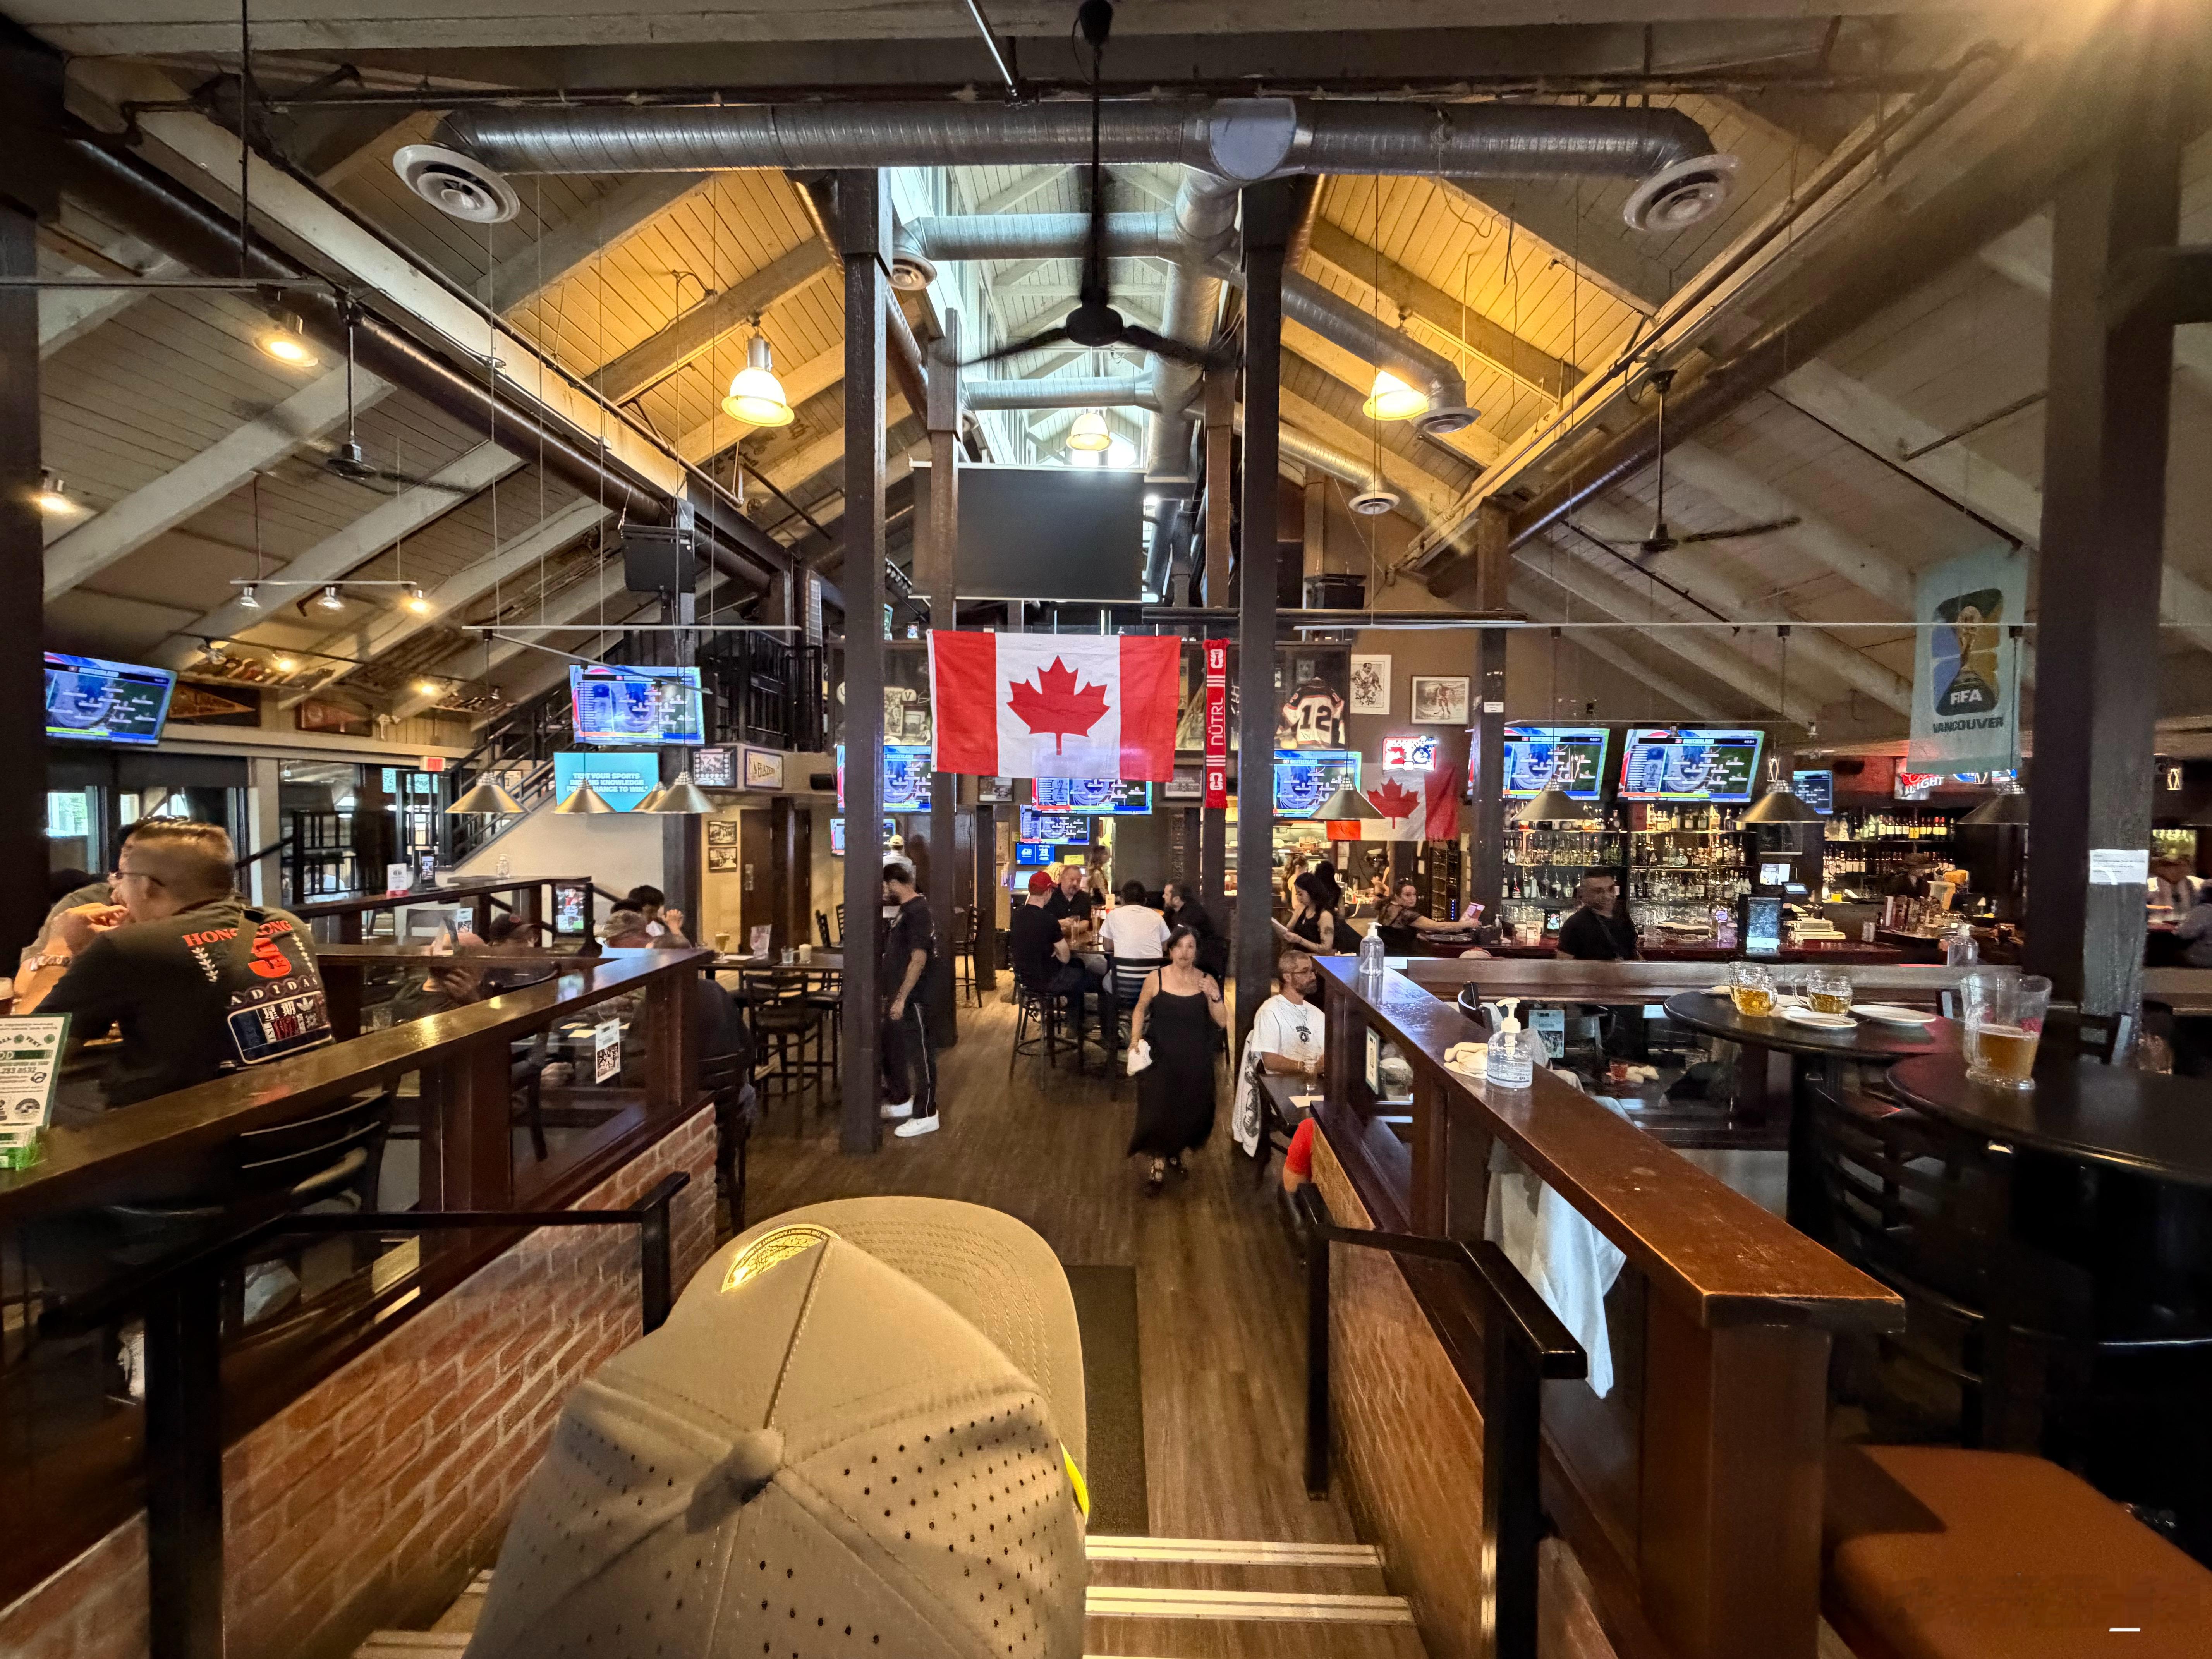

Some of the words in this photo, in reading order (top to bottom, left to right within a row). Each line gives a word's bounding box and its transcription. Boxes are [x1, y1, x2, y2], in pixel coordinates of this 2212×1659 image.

[1950, 689, 1983, 705] FIFA
[1300, 704, 1332, 732] 12
[1932, 716, 2004, 733] VANCOUVER
[1909, 776, 1944, 793] LIGHT
[256, 919, 294, 936] ONG
[231, 977, 318, 1006] ADIDAS
